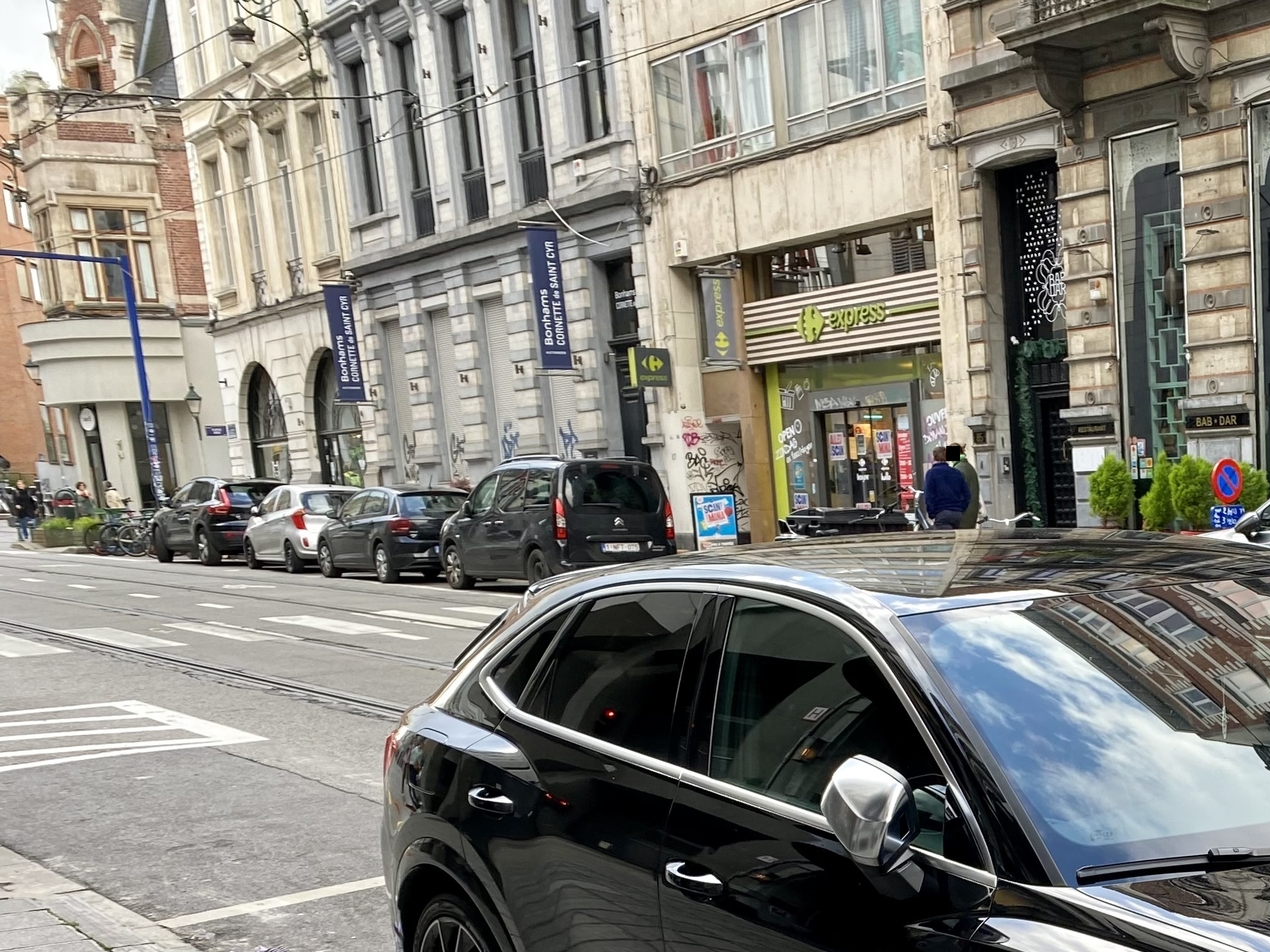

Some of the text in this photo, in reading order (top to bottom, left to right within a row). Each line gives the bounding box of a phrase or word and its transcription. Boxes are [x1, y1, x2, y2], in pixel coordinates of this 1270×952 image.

[544, 241, 554, 259] CYR
[547, 261, 559, 289] SAINT
[339, 296, 349, 310] CYR
[552, 290, 560, 300] de
[713, 279, 725, 327] express
[342, 312, 353, 335] SAINT
[539, 289, 554, 346] Bonhams
[551, 301, 566, 346] CORNETTE
[829, 302, 886, 333] express
[336, 335, 349, 382] Bonhams
[347, 344, 360, 382] CORNETTE
[640, 374, 668, 382] express
[1195, 415, 1237, 427] BAB DAR
[778, 425, 795, 443] OPEN
